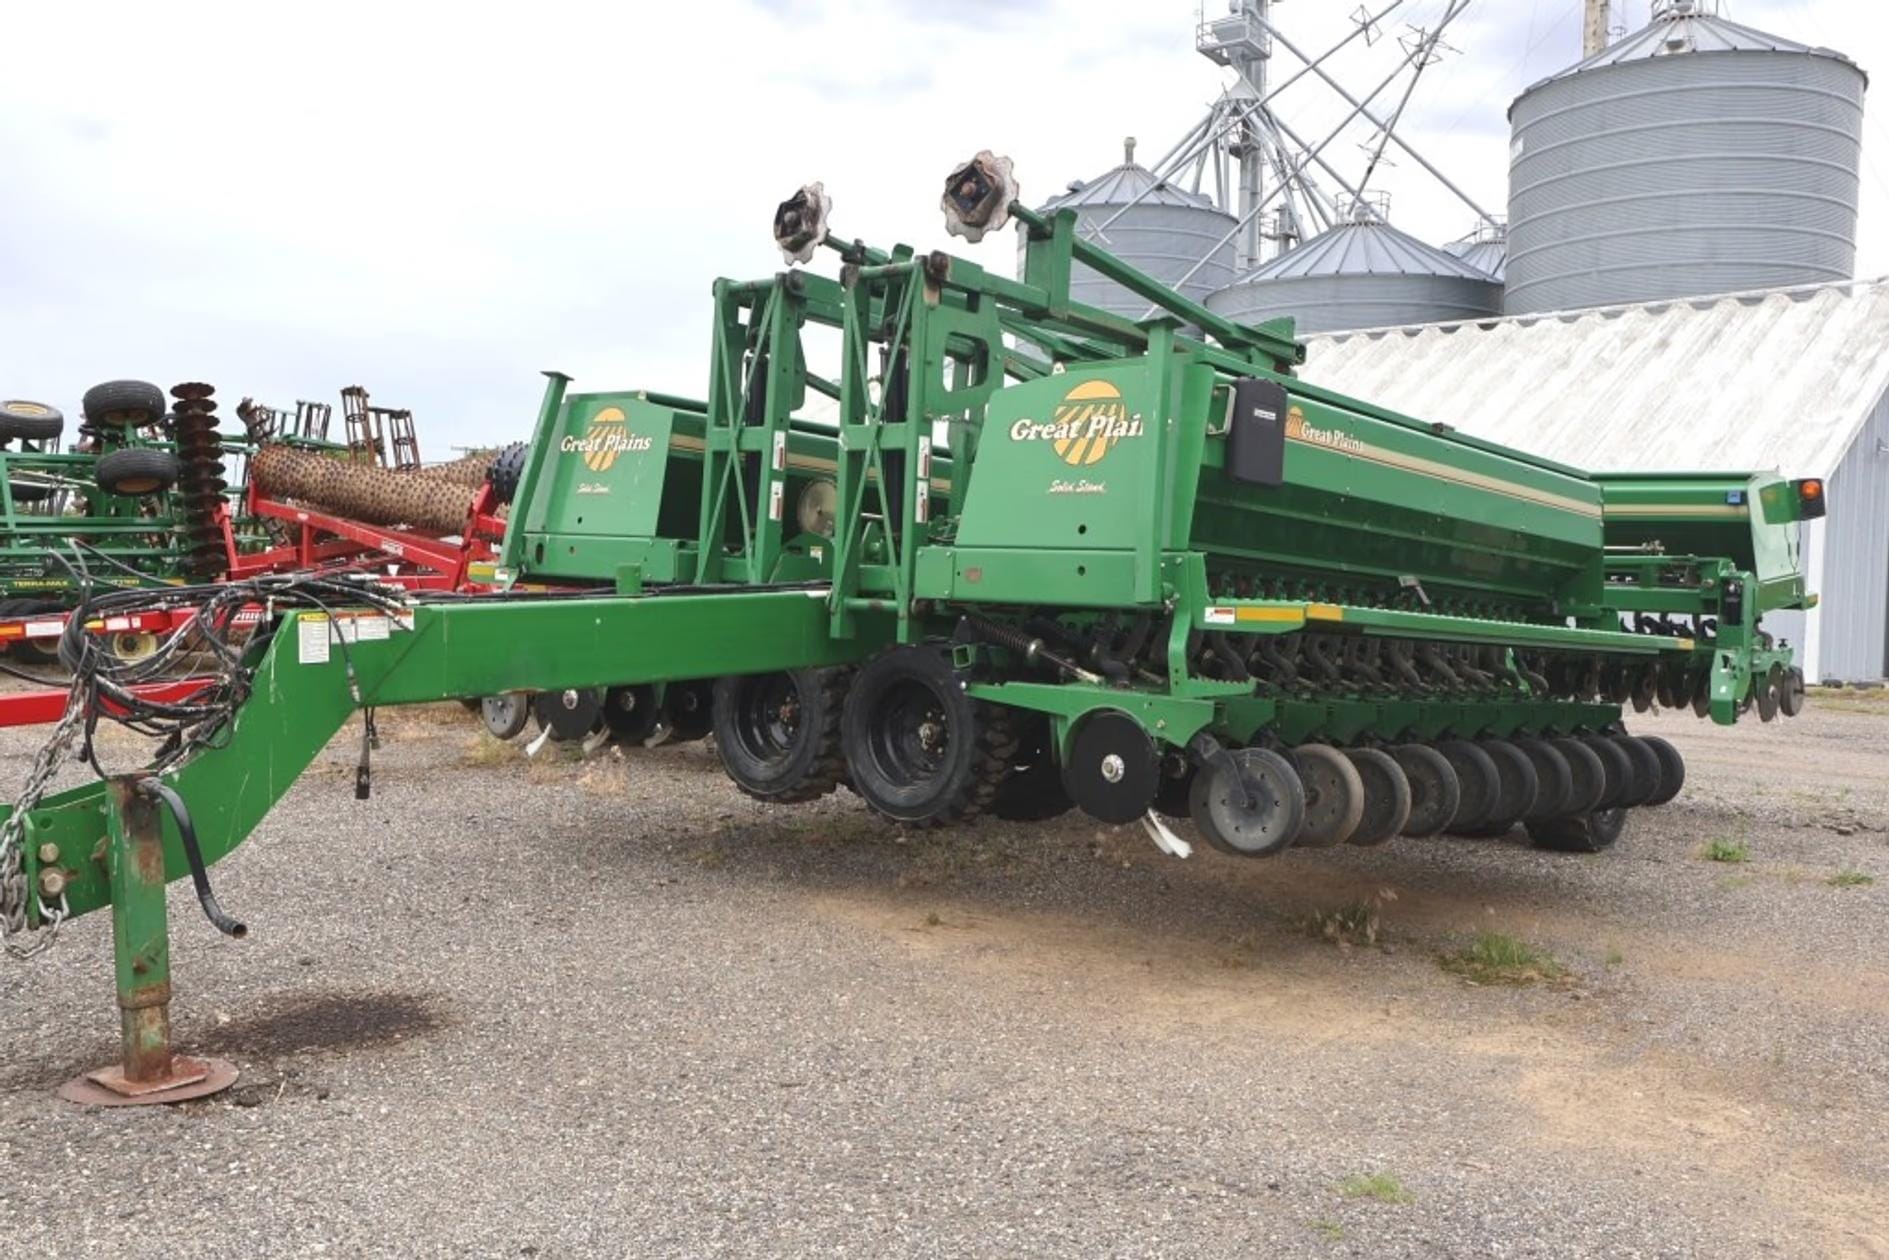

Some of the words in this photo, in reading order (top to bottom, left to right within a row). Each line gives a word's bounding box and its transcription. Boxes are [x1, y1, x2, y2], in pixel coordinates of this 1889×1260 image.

[1010, 419, 1081, 440] Great
[1301, 421, 1332, 444] Great
[561, 435, 601, 452] Great
[603, 433, 653, 452] Plains
